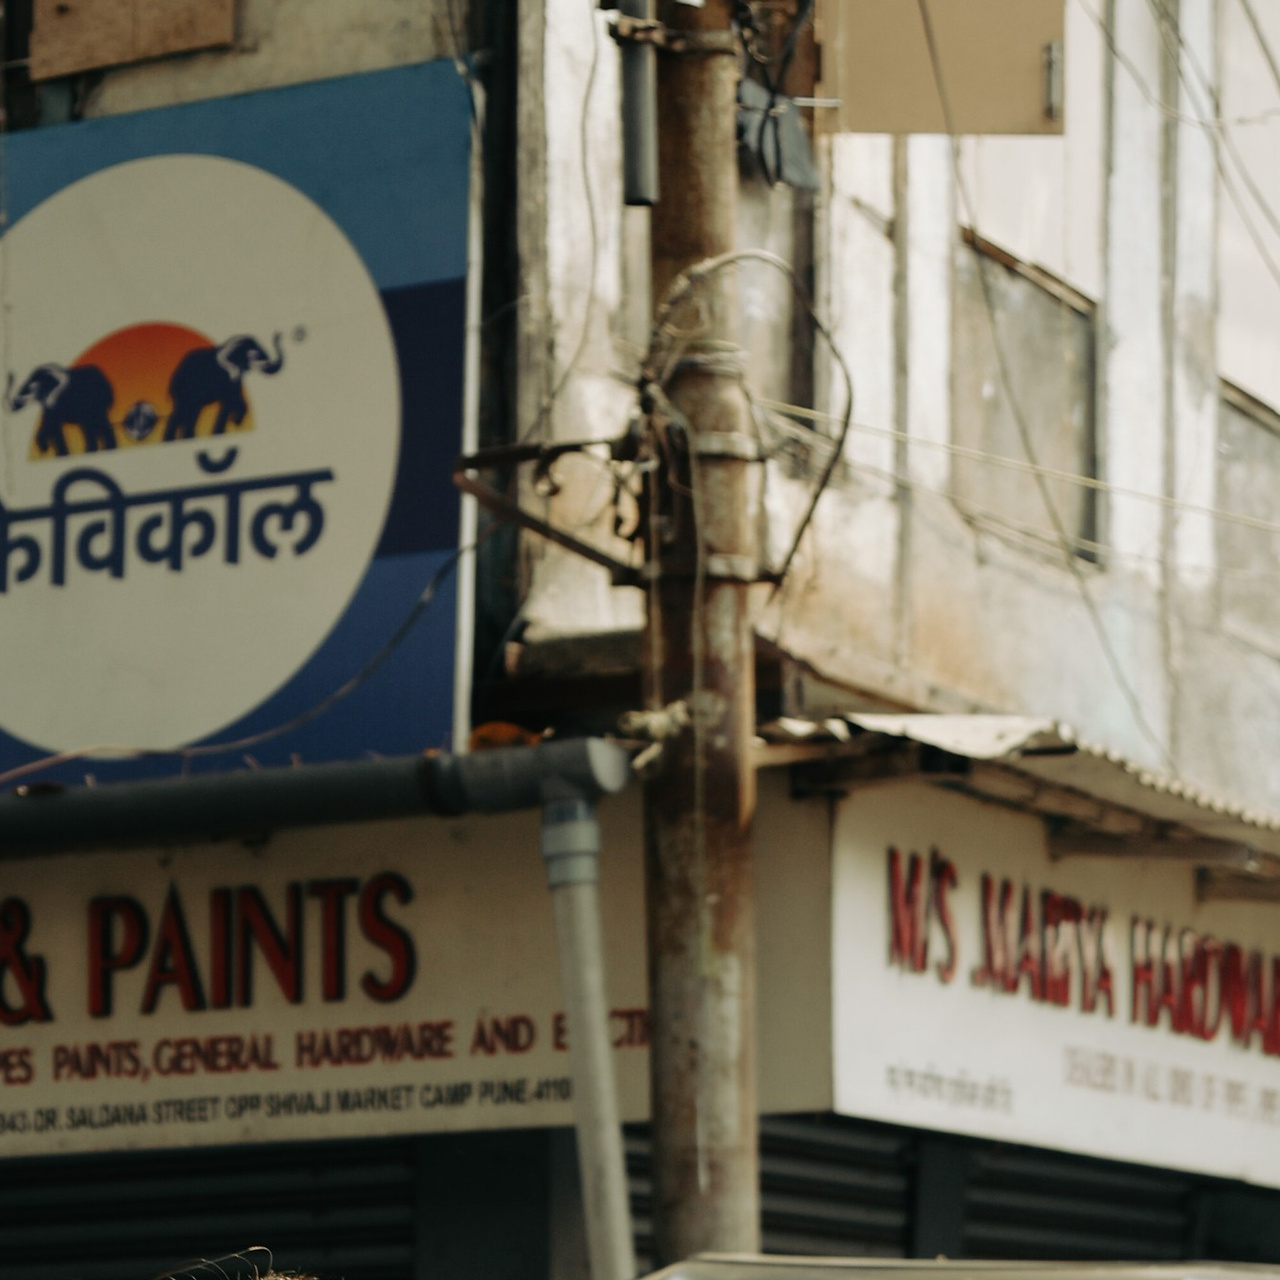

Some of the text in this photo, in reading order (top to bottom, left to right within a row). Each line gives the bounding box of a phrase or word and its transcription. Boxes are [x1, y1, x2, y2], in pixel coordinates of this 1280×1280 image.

[86, 871, 418, 1018] PAINTS
[295, 1019, 455, 1068] HARDWARE
[470, 1014, 538, 1057] AND
[153, 1094, 219, 1126] STREET
[335, 1084, 415, 1113] MARKET
[419, 1080, 473, 1109] CAMP
